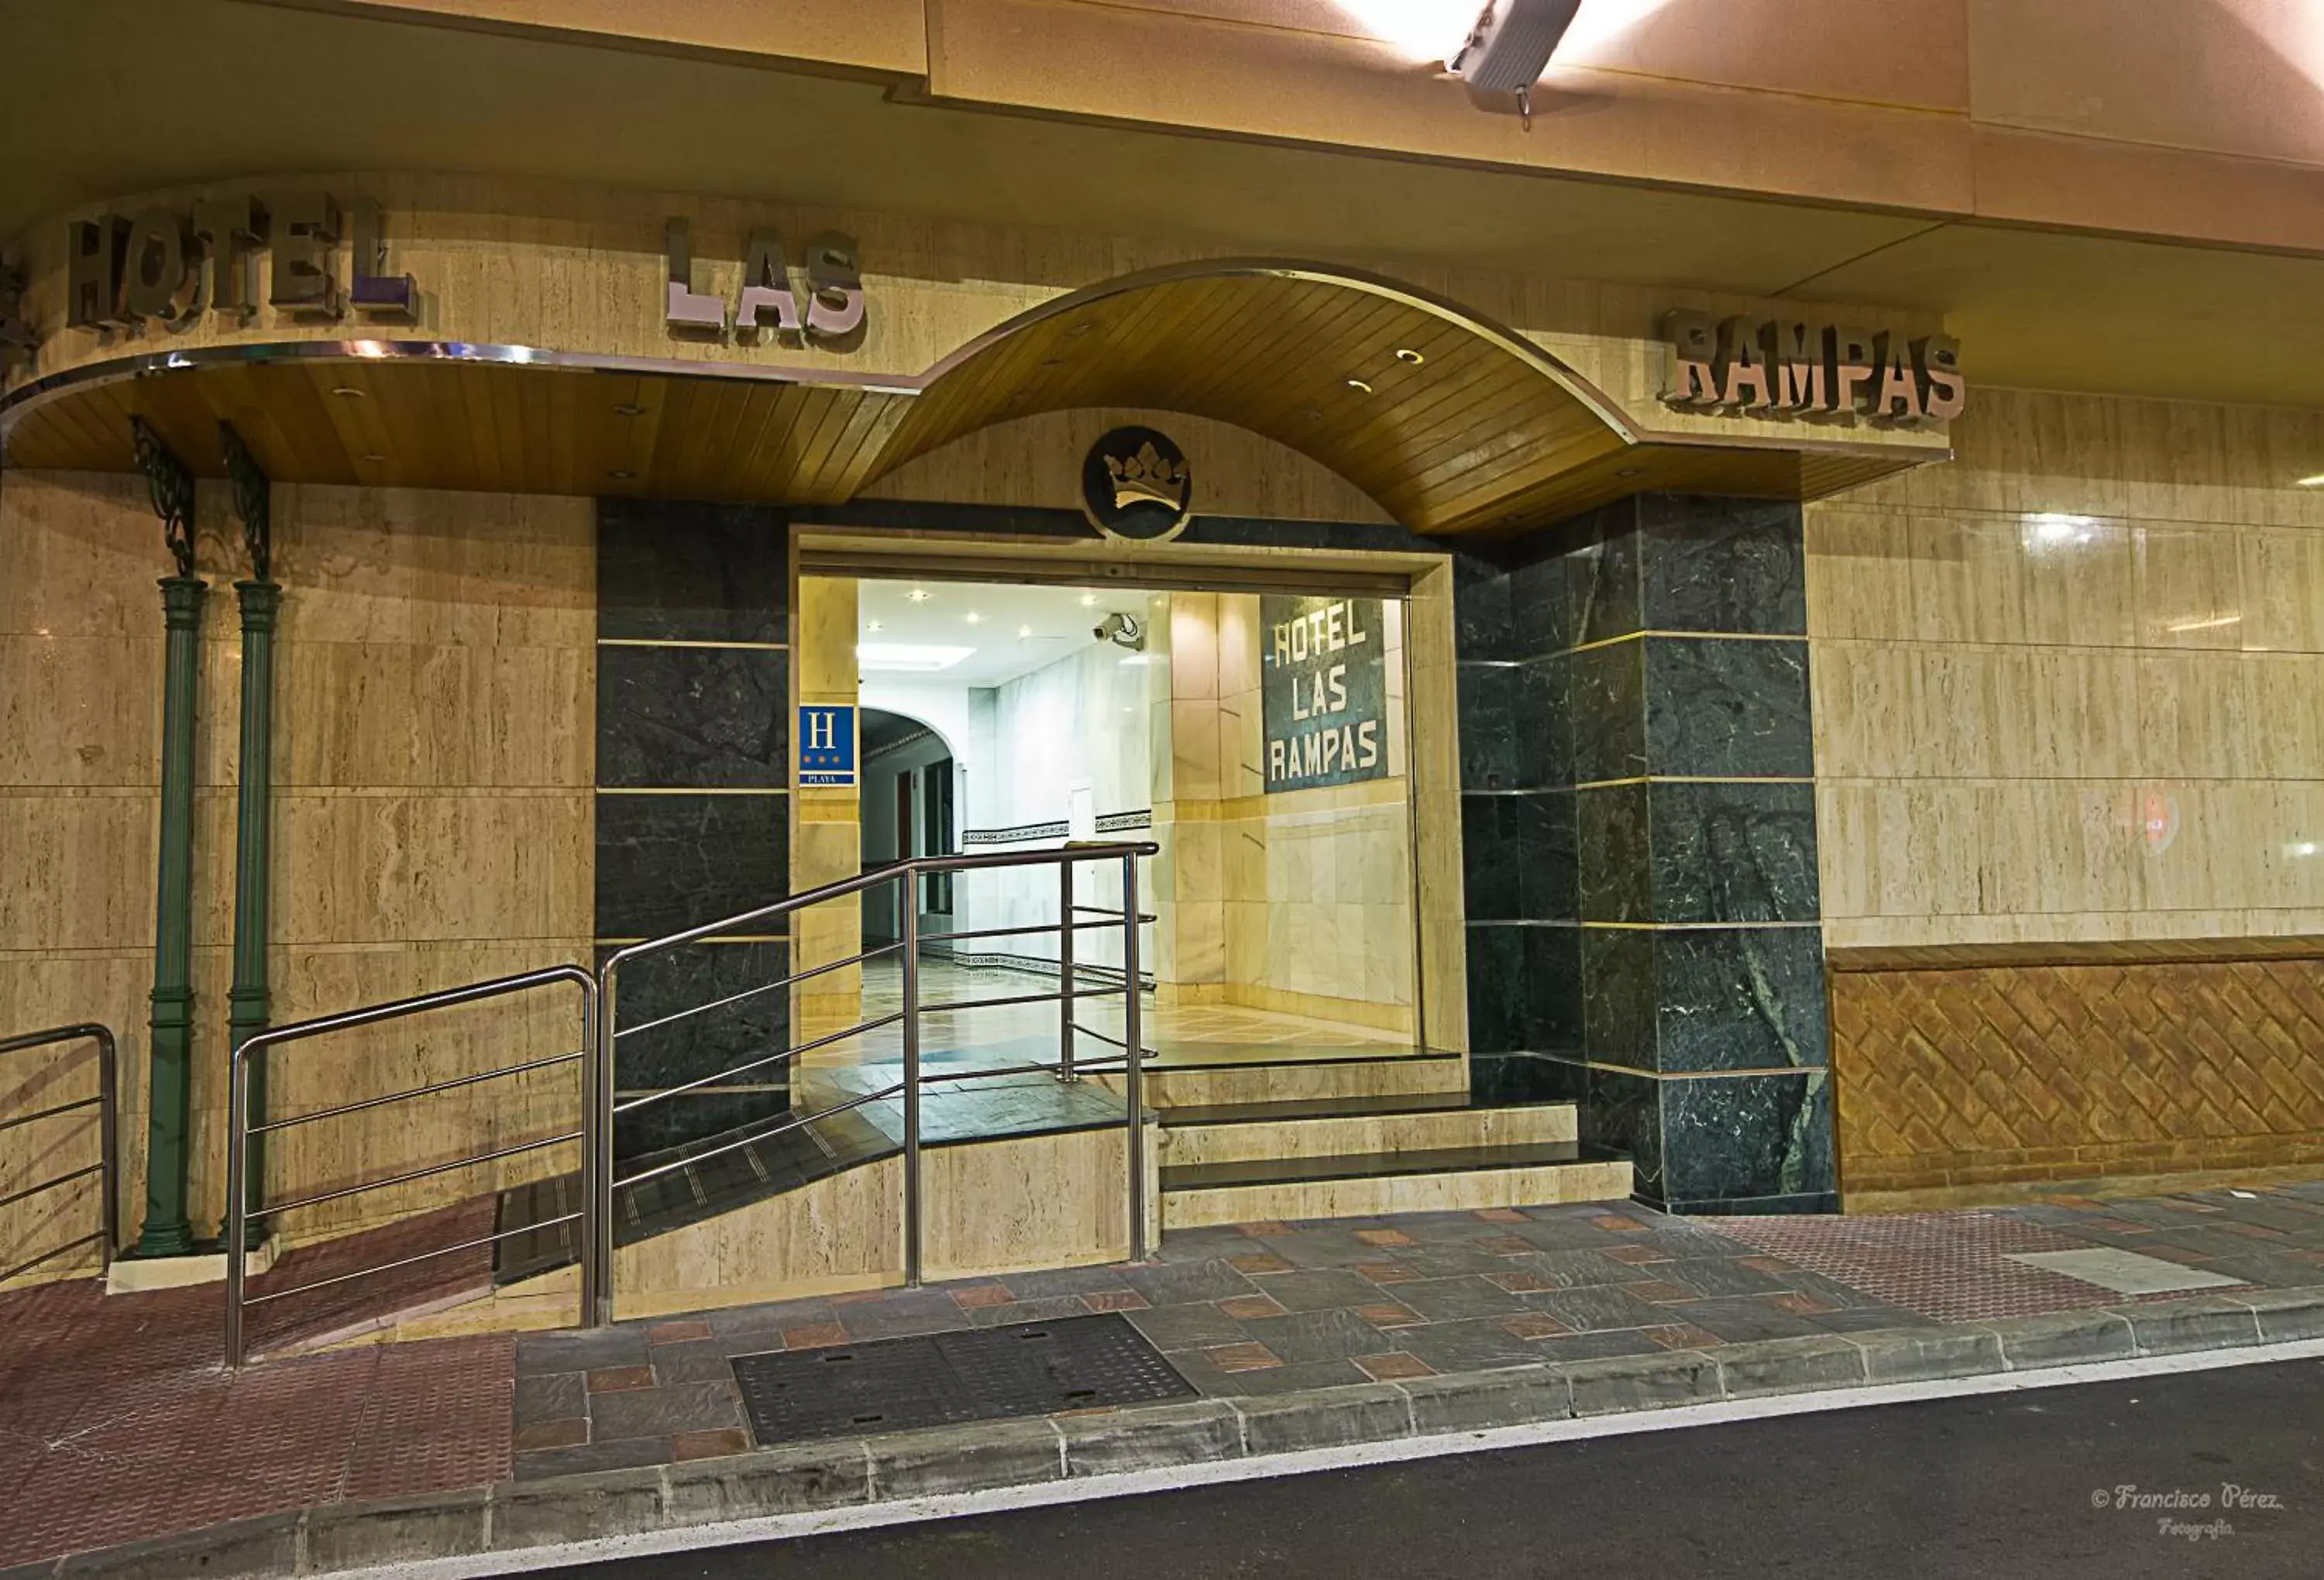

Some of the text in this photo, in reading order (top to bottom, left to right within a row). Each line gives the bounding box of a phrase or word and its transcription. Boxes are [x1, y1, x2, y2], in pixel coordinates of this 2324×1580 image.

[68, 191, 1965, 421] HOTEL LAS RAMPAS
[1274, 599, 1366, 668] HOTEL
[1292, 664, 1347, 721] LAS
[806, 712, 837, 750] H
[1270, 720, 1377, 782] RAMPAS
[808, 775, 836, 784] PLAYA
